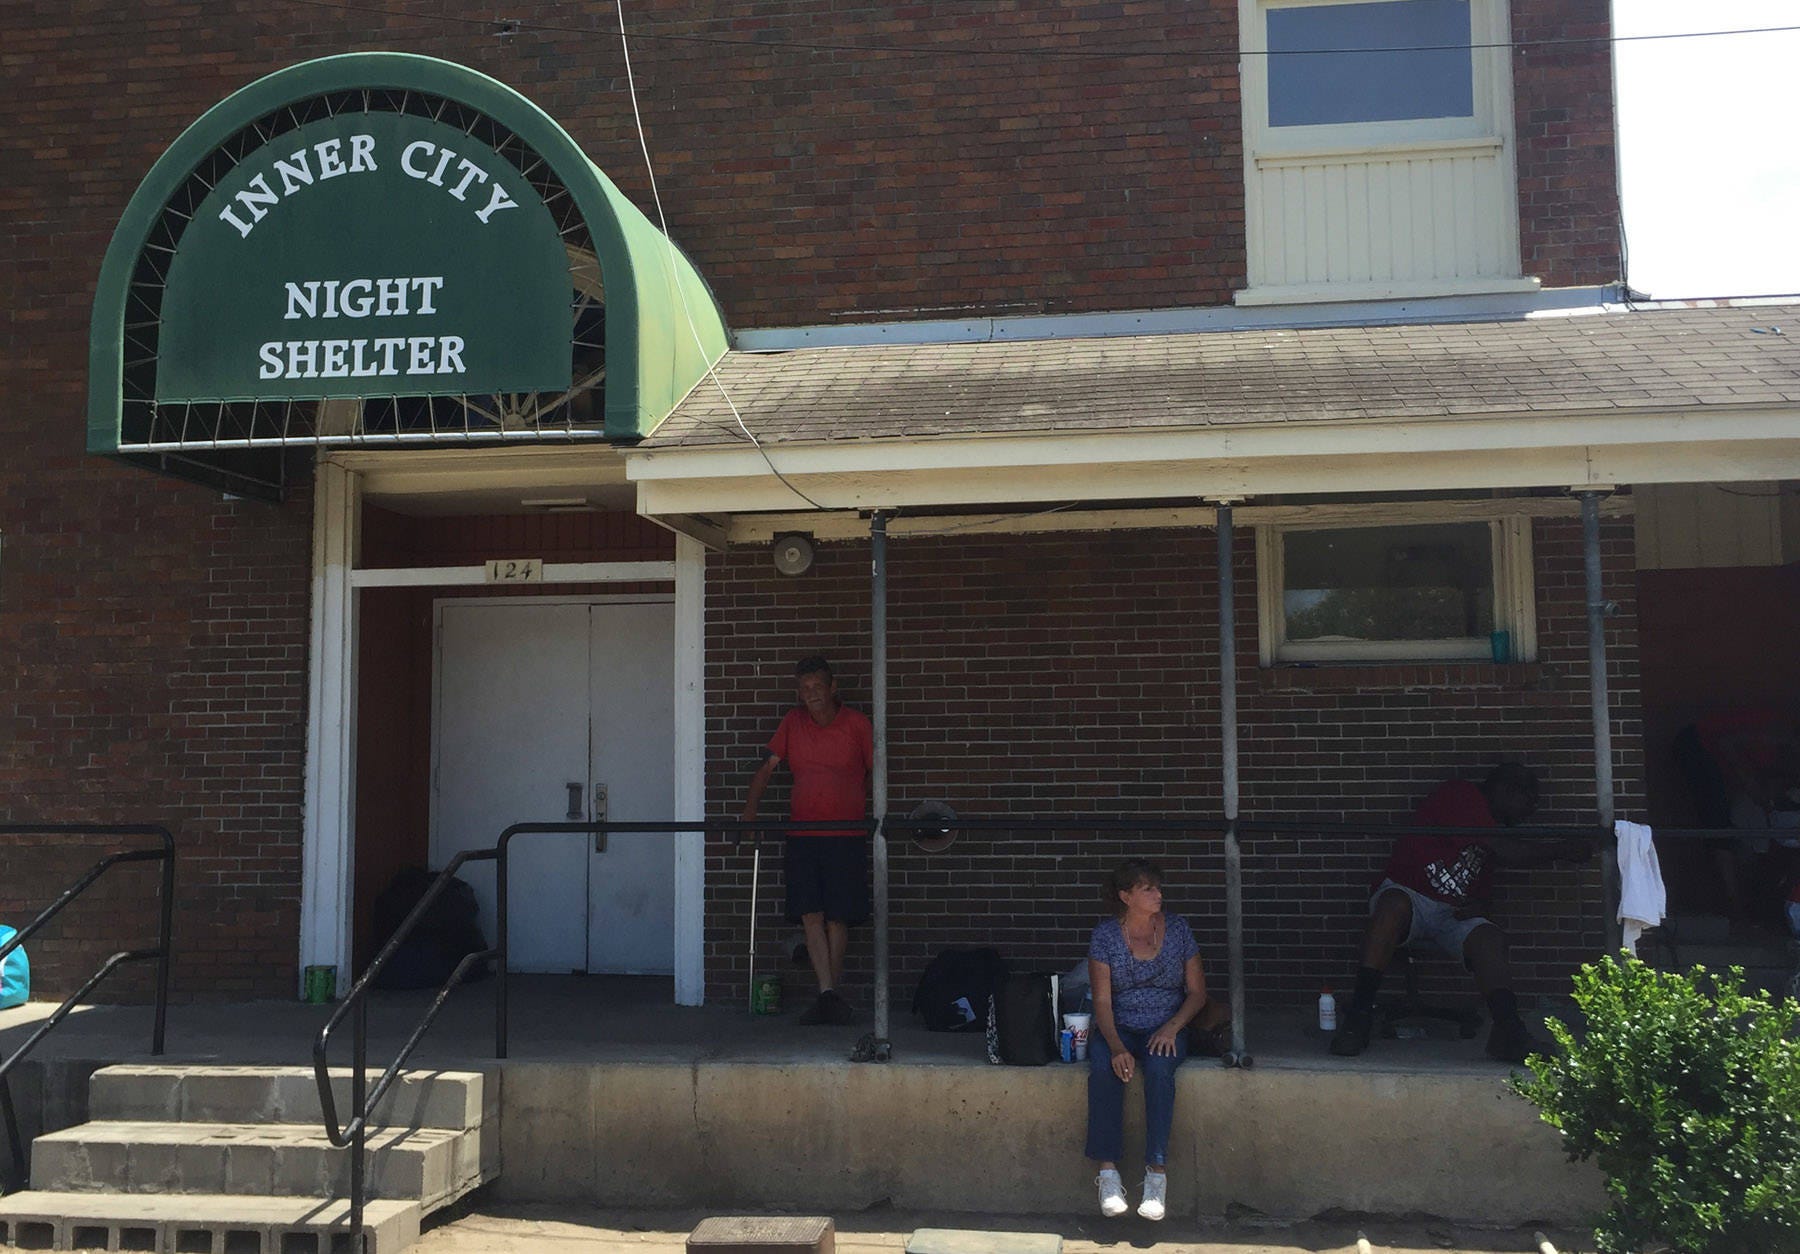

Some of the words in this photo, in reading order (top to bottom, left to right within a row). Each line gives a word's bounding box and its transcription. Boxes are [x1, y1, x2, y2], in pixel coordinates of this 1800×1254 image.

[219, 134, 378, 239] INNER
[400, 140, 519, 224] CITY
[284, 276, 444, 320] NIGHT
[259, 335, 467, 380] SHELTER
[494, 561, 533, 580] 124
